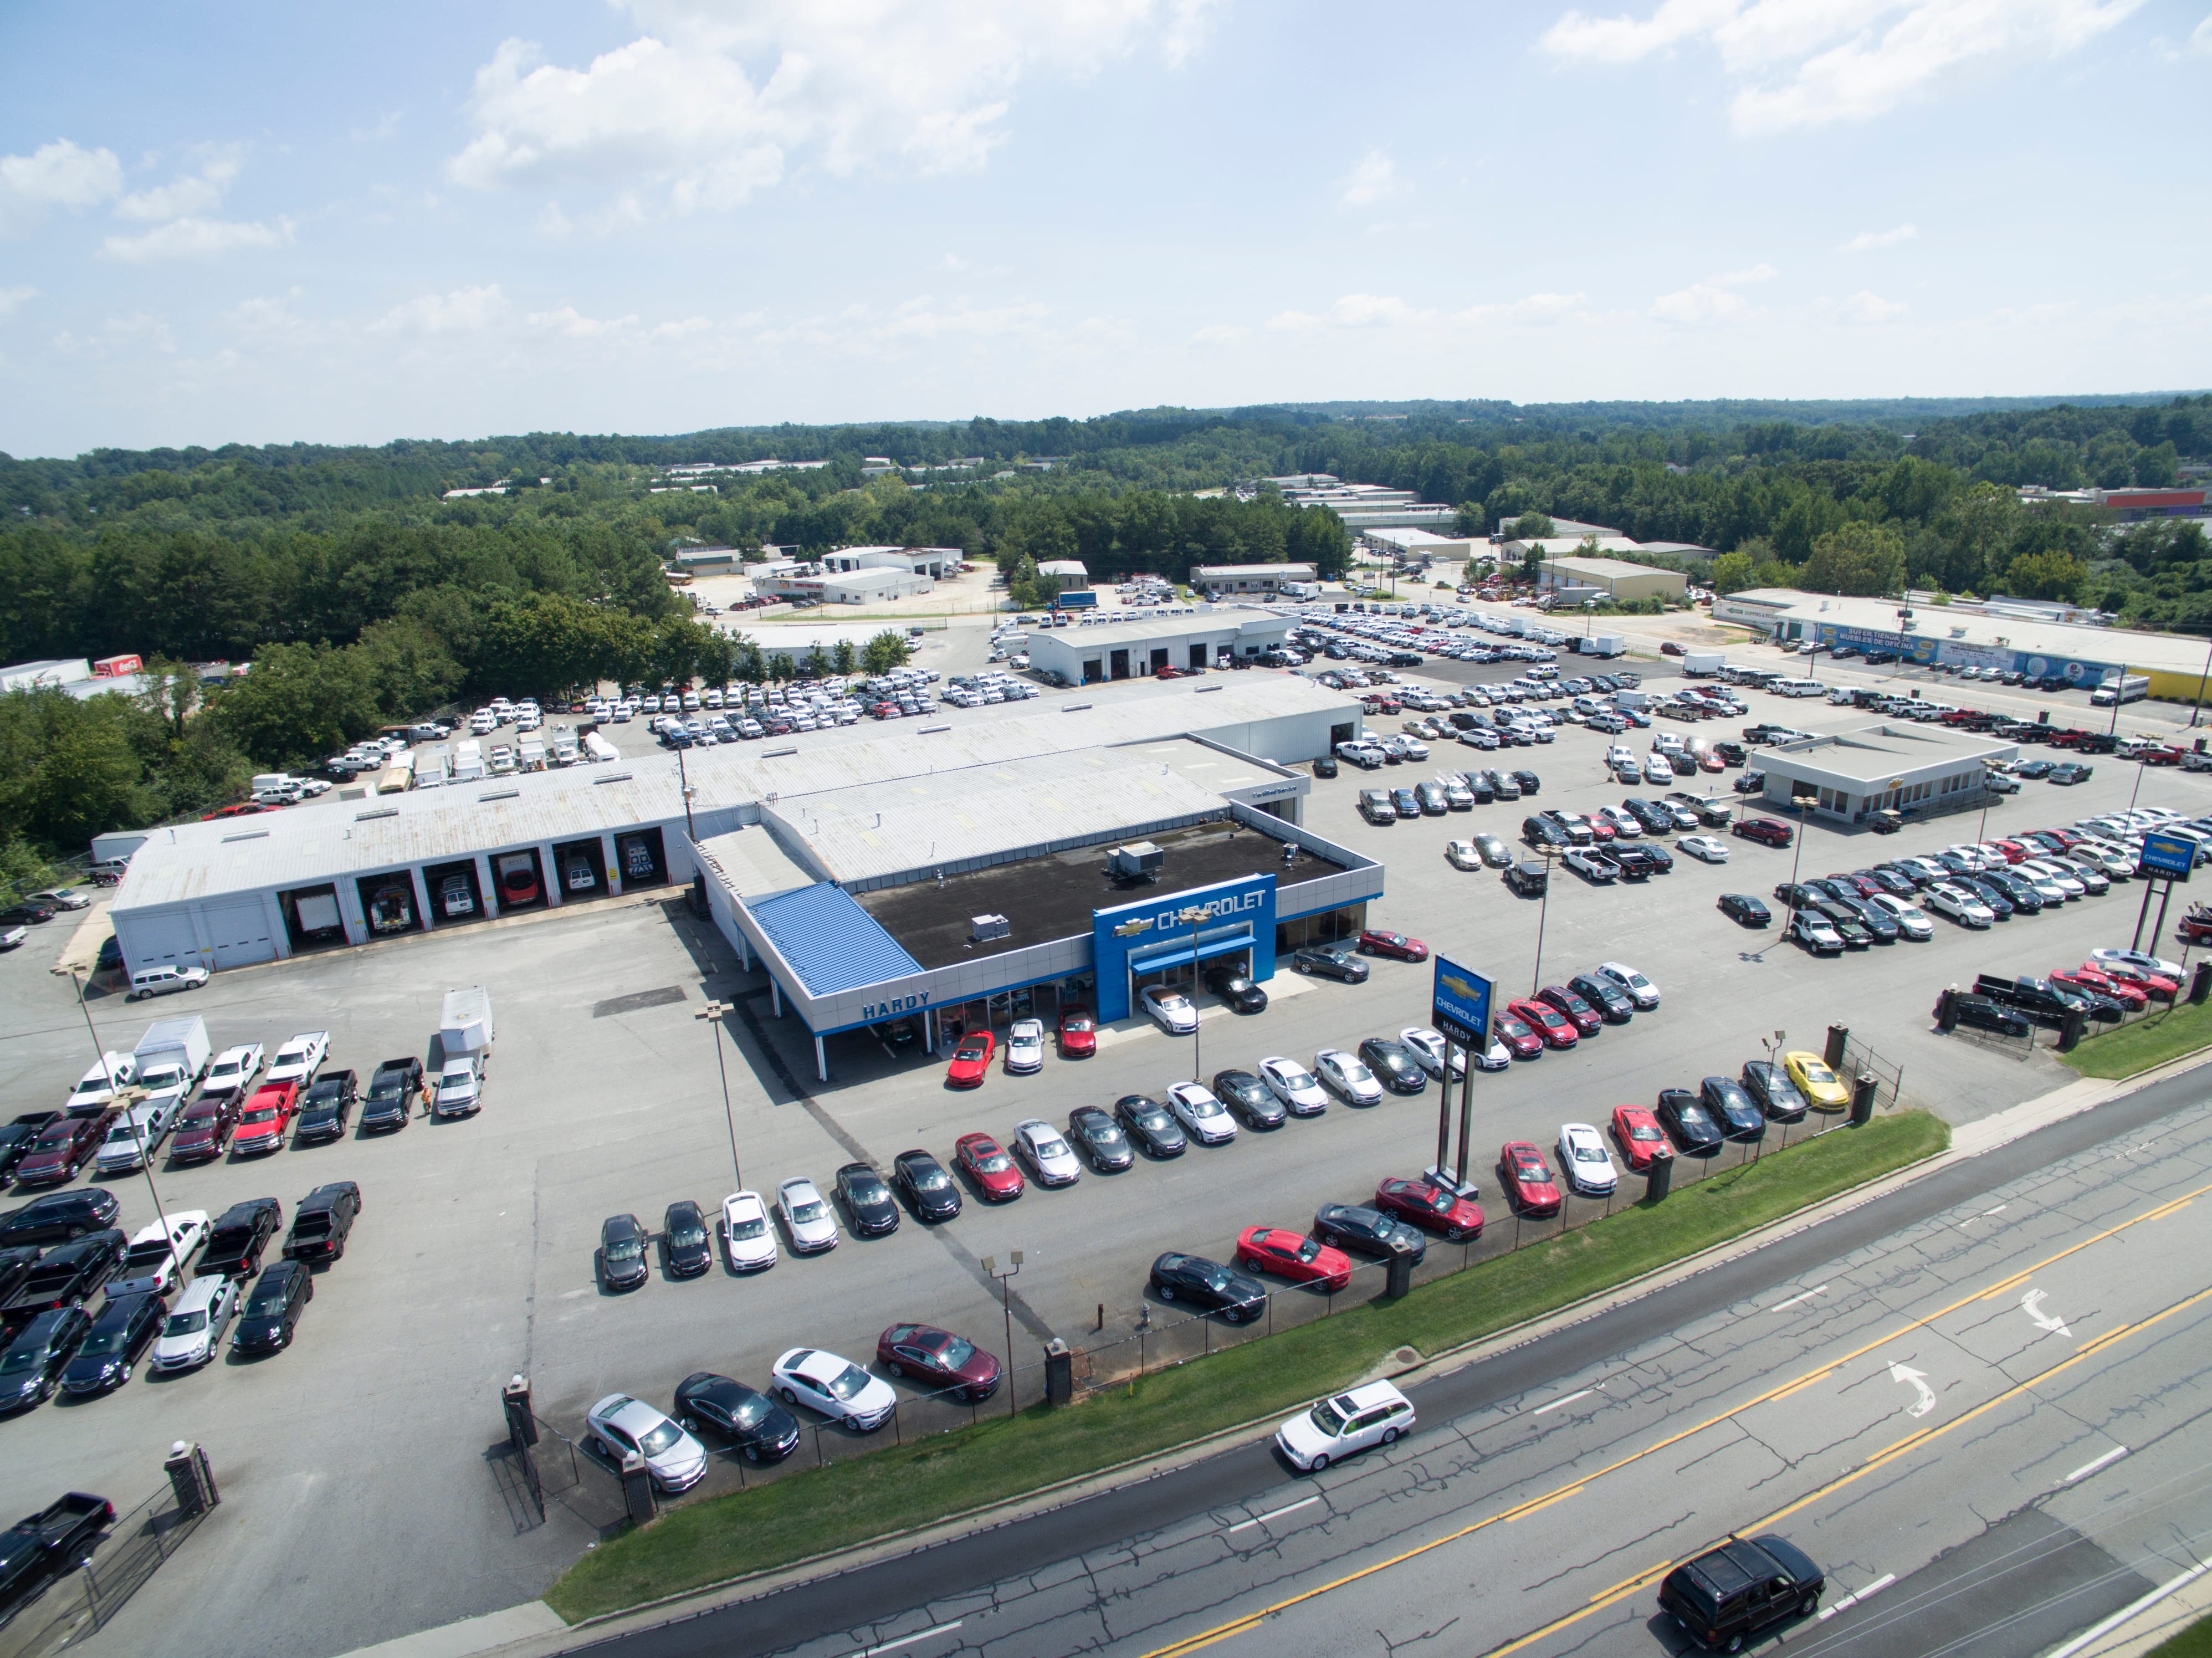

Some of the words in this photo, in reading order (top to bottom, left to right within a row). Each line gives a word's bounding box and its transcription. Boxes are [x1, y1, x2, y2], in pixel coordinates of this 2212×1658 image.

[1839, 633, 1872, 644] MUEBLES
[1884, 641, 1913, 651] OFICINA
[1847, 628, 1873, 637] SUPER
[1874, 632, 1899, 642] TIENDA
[1253, 789, 1277, 799] Certified
[1277, 785, 1297, 794] Service
[2145, 854, 2186, 868] CHEVROLET
[2148, 866, 2177, 878] HARDY
[1158, 889, 1266, 930] CHROLET
[863, 990, 930, 1019] HARDY
[1436, 996, 1482, 1027] CHEVROLET
[1443, 1020, 1471, 1042] HARDY
